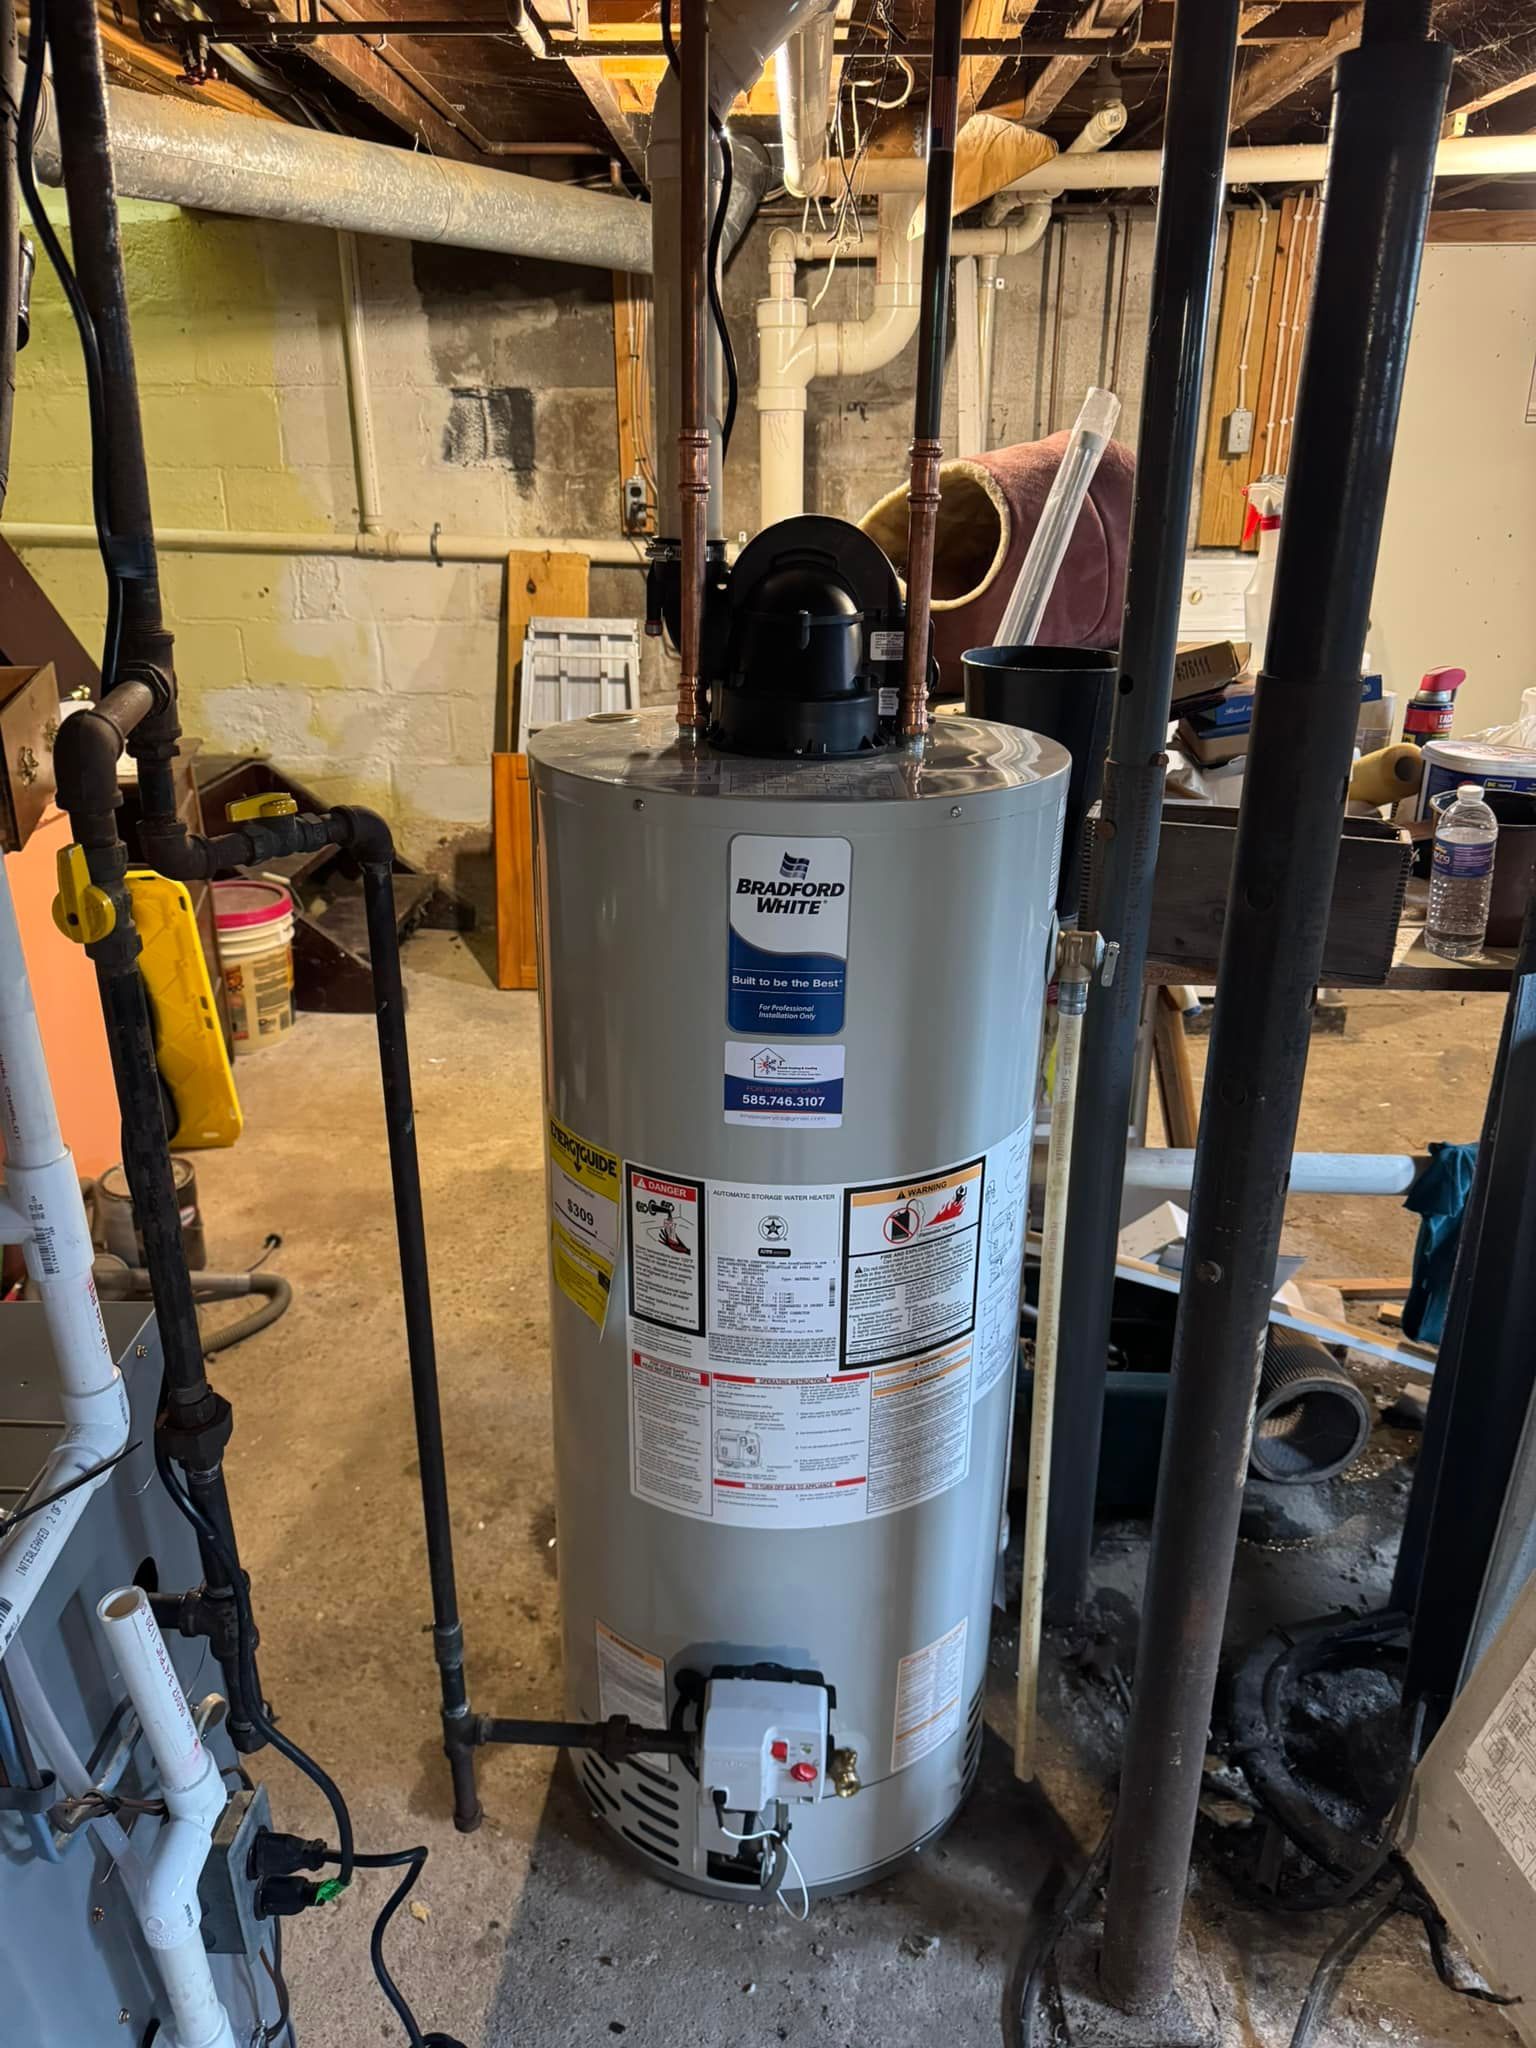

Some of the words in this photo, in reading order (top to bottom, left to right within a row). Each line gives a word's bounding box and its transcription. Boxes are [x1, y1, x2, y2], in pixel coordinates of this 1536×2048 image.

[737, 878, 845, 898] BRADFORD
[732, 975, 756, 986] Built
[759, 977, 770, 986] to
[773, 977, 788, 987] be
[792, 977, 810, 987] the
[759, 1003, 770, 1012] For
[771, 1004, 814, 1013] Professional
[758, 1011, 798, 1020] Installation
[799, 1012, 816, 1021] Only
[742, 1094, 826, 1107] 585.746.3107
[648, 1181, 687, 1199] DANGER
[713, 1190, 751, 1199] AUTOMATIC
[751, 1193, 783, 1201] STORAGE
[908, 1181, 948, 1198] WARNING
[15, 1526, 51, 1578] INTERLEAVED
[46, 1513, 57, 1526] 2
[52, 1502, 64, 1515] OF
